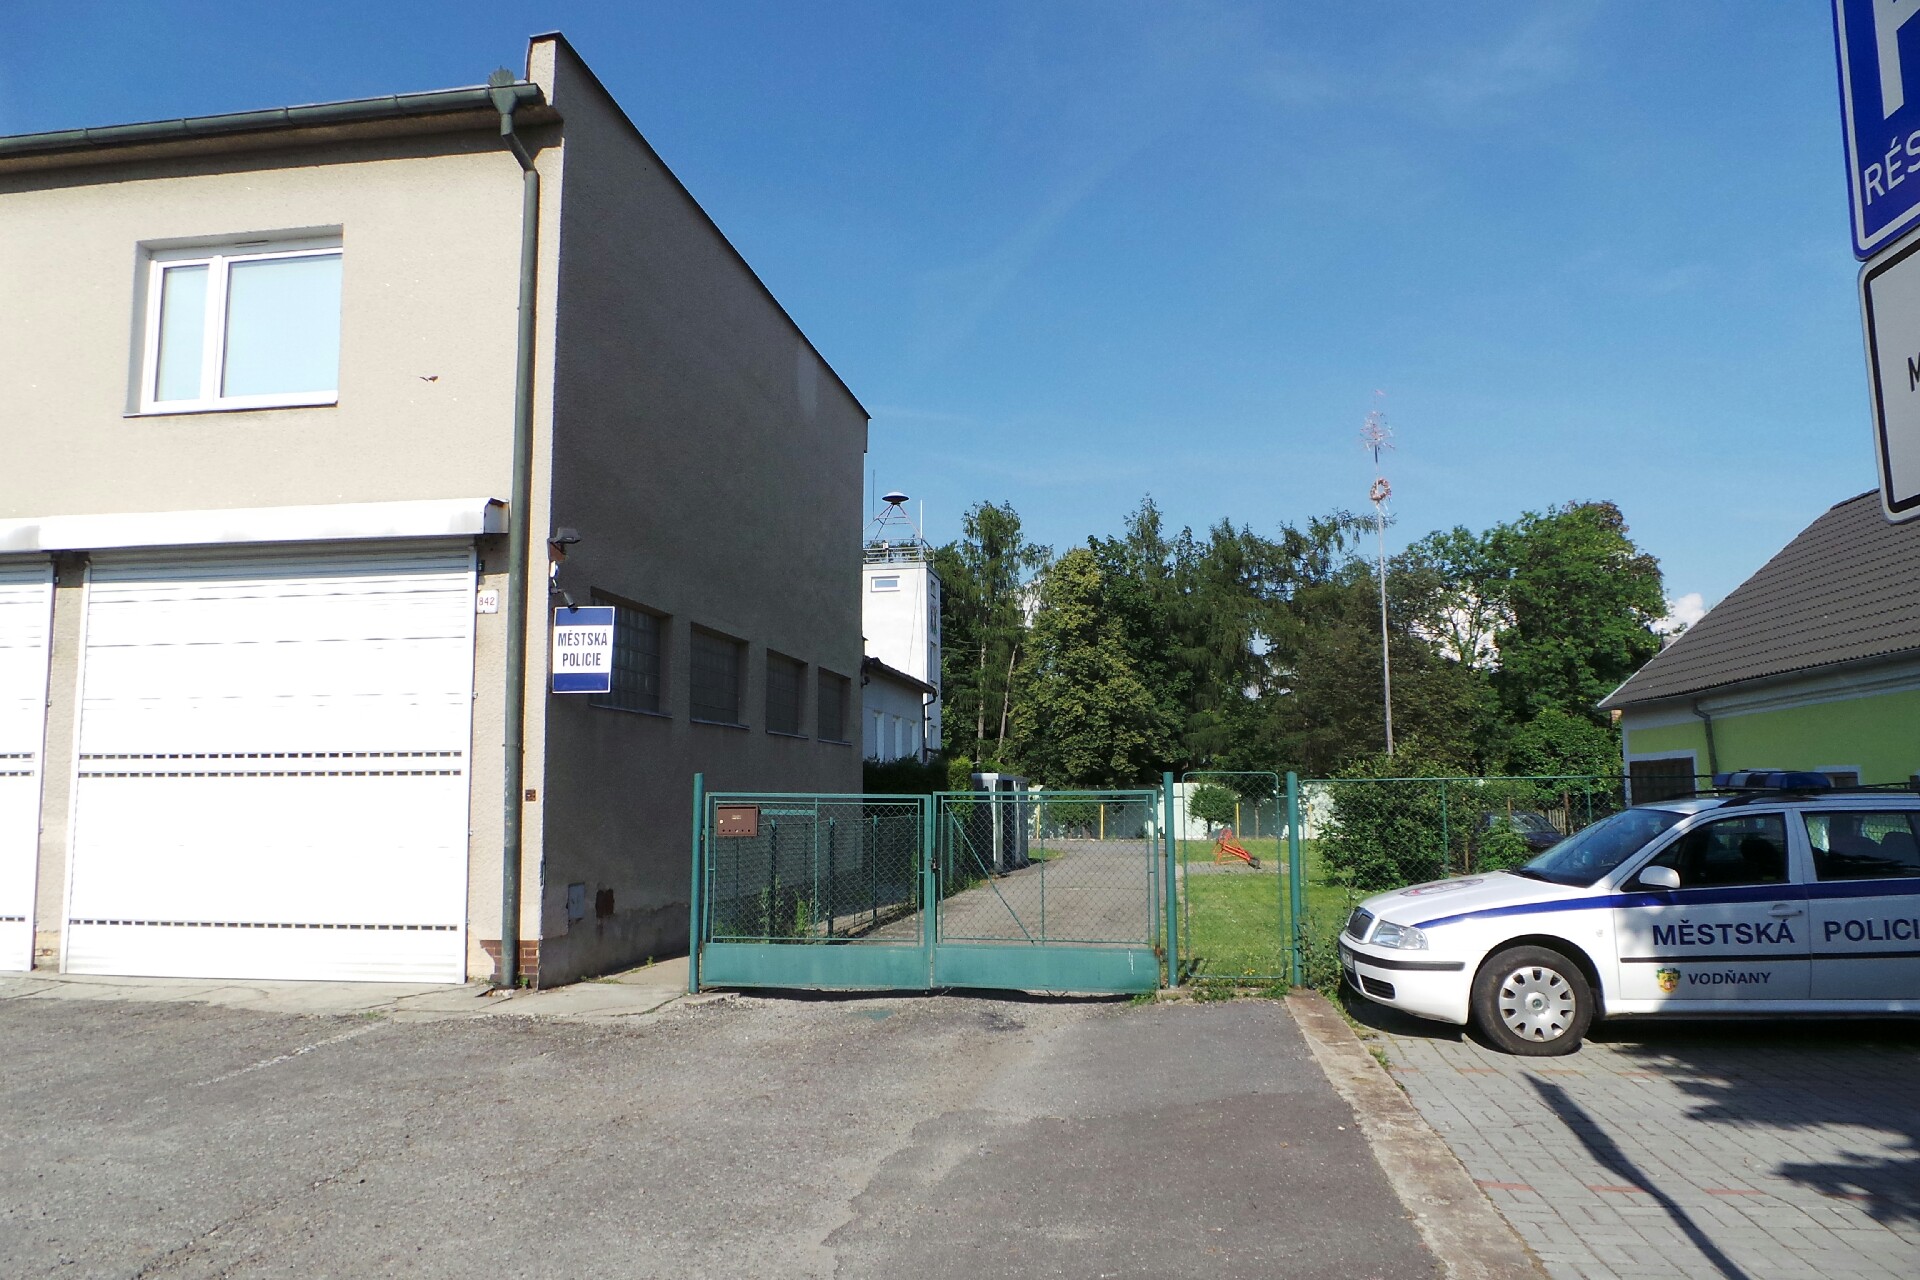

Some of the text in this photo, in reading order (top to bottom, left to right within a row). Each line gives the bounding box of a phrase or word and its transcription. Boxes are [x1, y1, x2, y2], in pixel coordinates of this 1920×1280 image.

[478, 596, 495, 606] 842
[557, 629, 608, 646] MĚSTSKÁ
[562, 652, 602, 667] POLICIE
[1652, 918, 1920, 946] MĚSTSKÁ POLICI
[1688, 969, 1771, 985] VODŇANY
